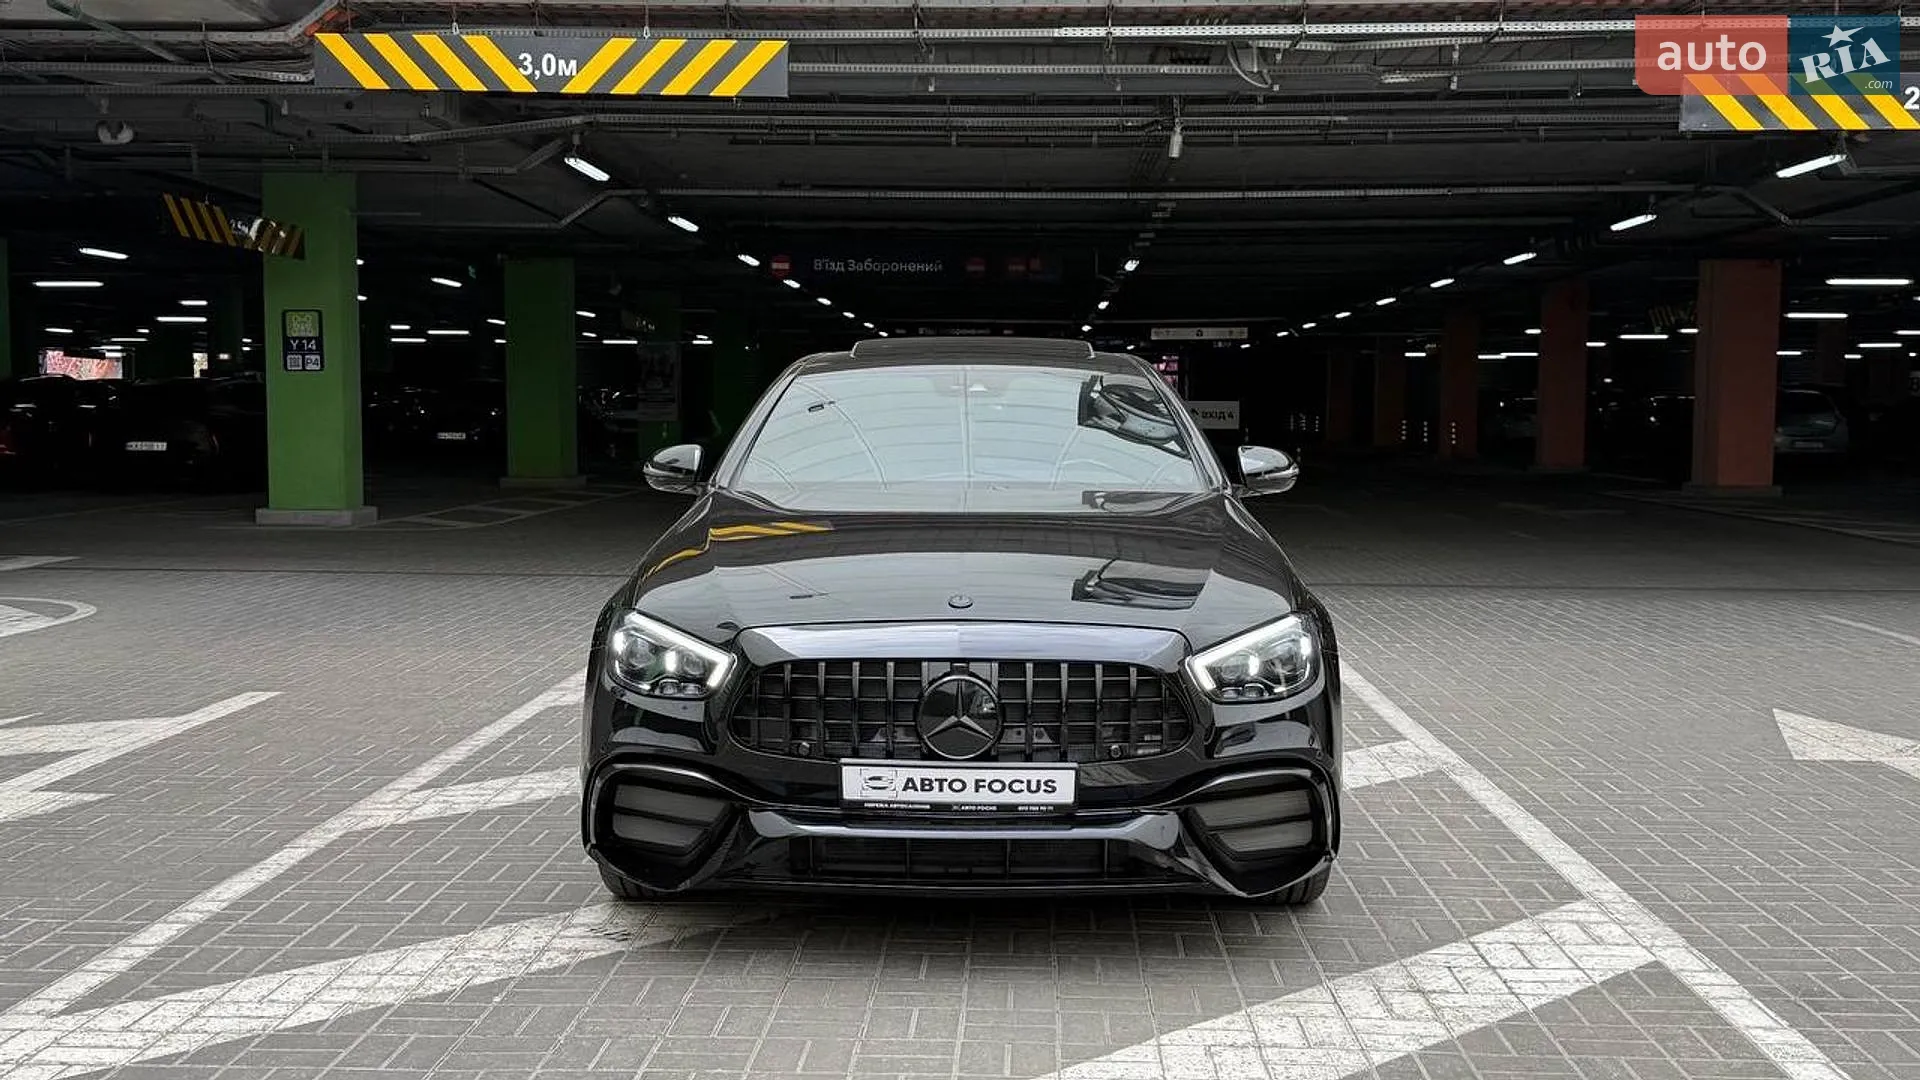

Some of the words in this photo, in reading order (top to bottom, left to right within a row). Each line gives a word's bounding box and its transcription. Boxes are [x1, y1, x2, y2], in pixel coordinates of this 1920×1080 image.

[518, 52, 577, 80] 3,0м
[847, 257, 944, 274] Заборонений
[301, 339, 317, 350] 14
[974, 778, 1058, 794] FOCUS
